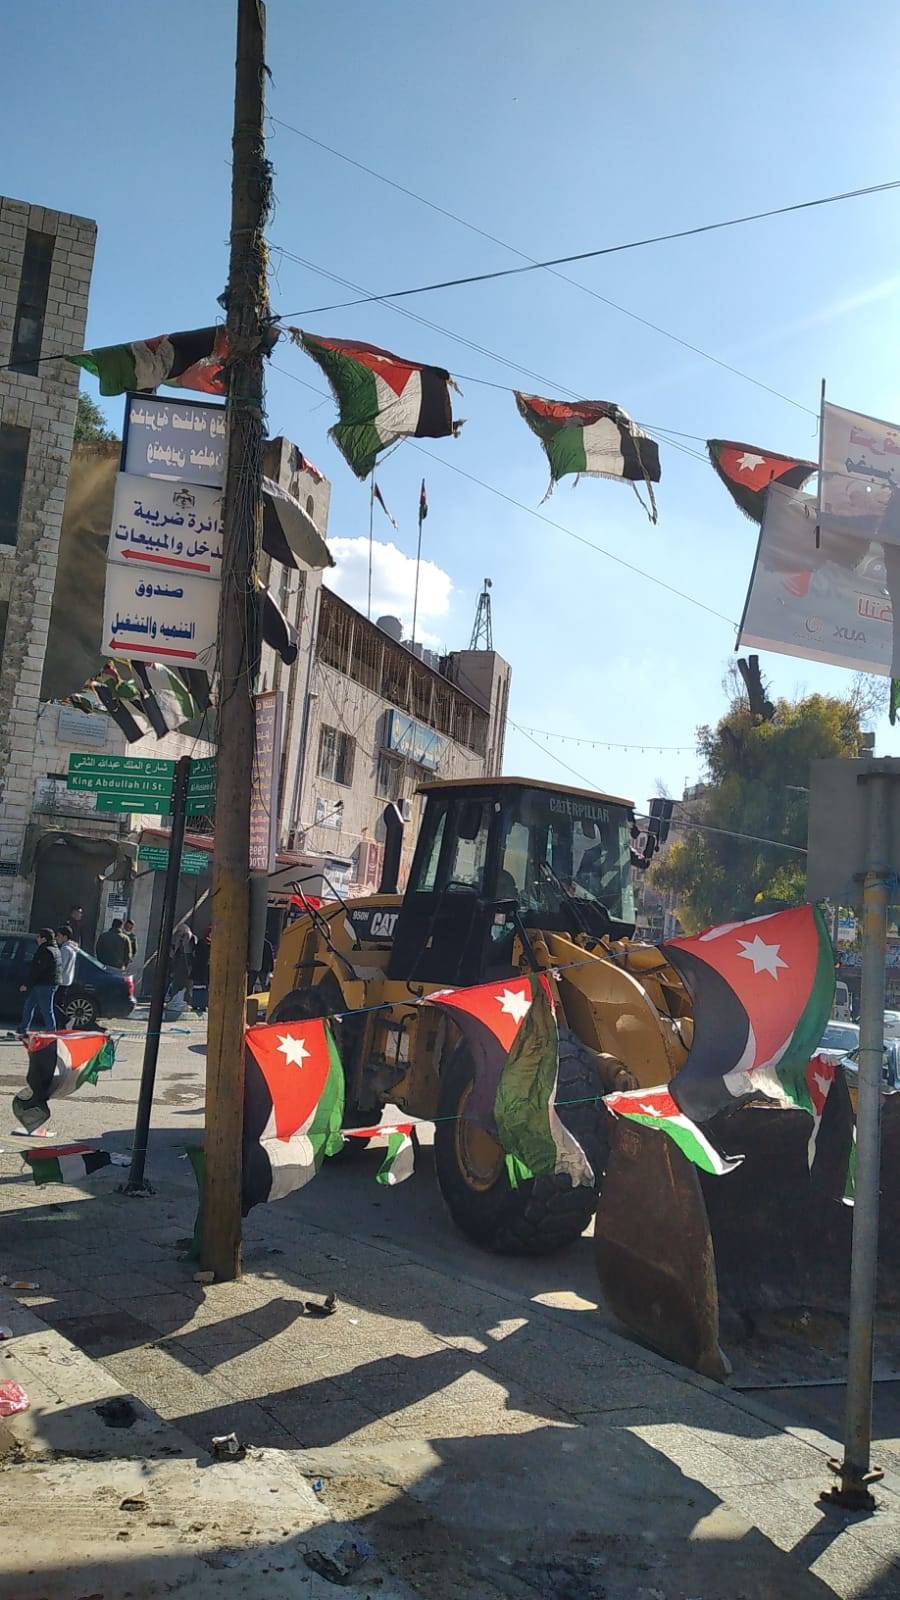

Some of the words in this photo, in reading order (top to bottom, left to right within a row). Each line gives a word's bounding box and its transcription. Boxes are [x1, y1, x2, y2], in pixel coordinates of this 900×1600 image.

[134, 500, 185, 527] ضريبة
[115, 525, 183, 555] والمبيعات
[135, 580, 184, 598] صندوق
[111, 612, 157, 639] والتشغيل
[98, 758, 120, 769] عبدالله
[123, 760, 143, 770] الملك
[145, 765, 168, 774] شارع
[72, 776, 93, 787] King
[96, 778, 140, 789] Abdullah
[143, 781, 150, 790] II
[152, 783, 165, 791] St.
[153, 802, 160, 811] 1
[550, 798, 610, 822] CATERPILLAR
[352, 910, 370, 921] 950H
[370, 912, 399, 936] CAT
